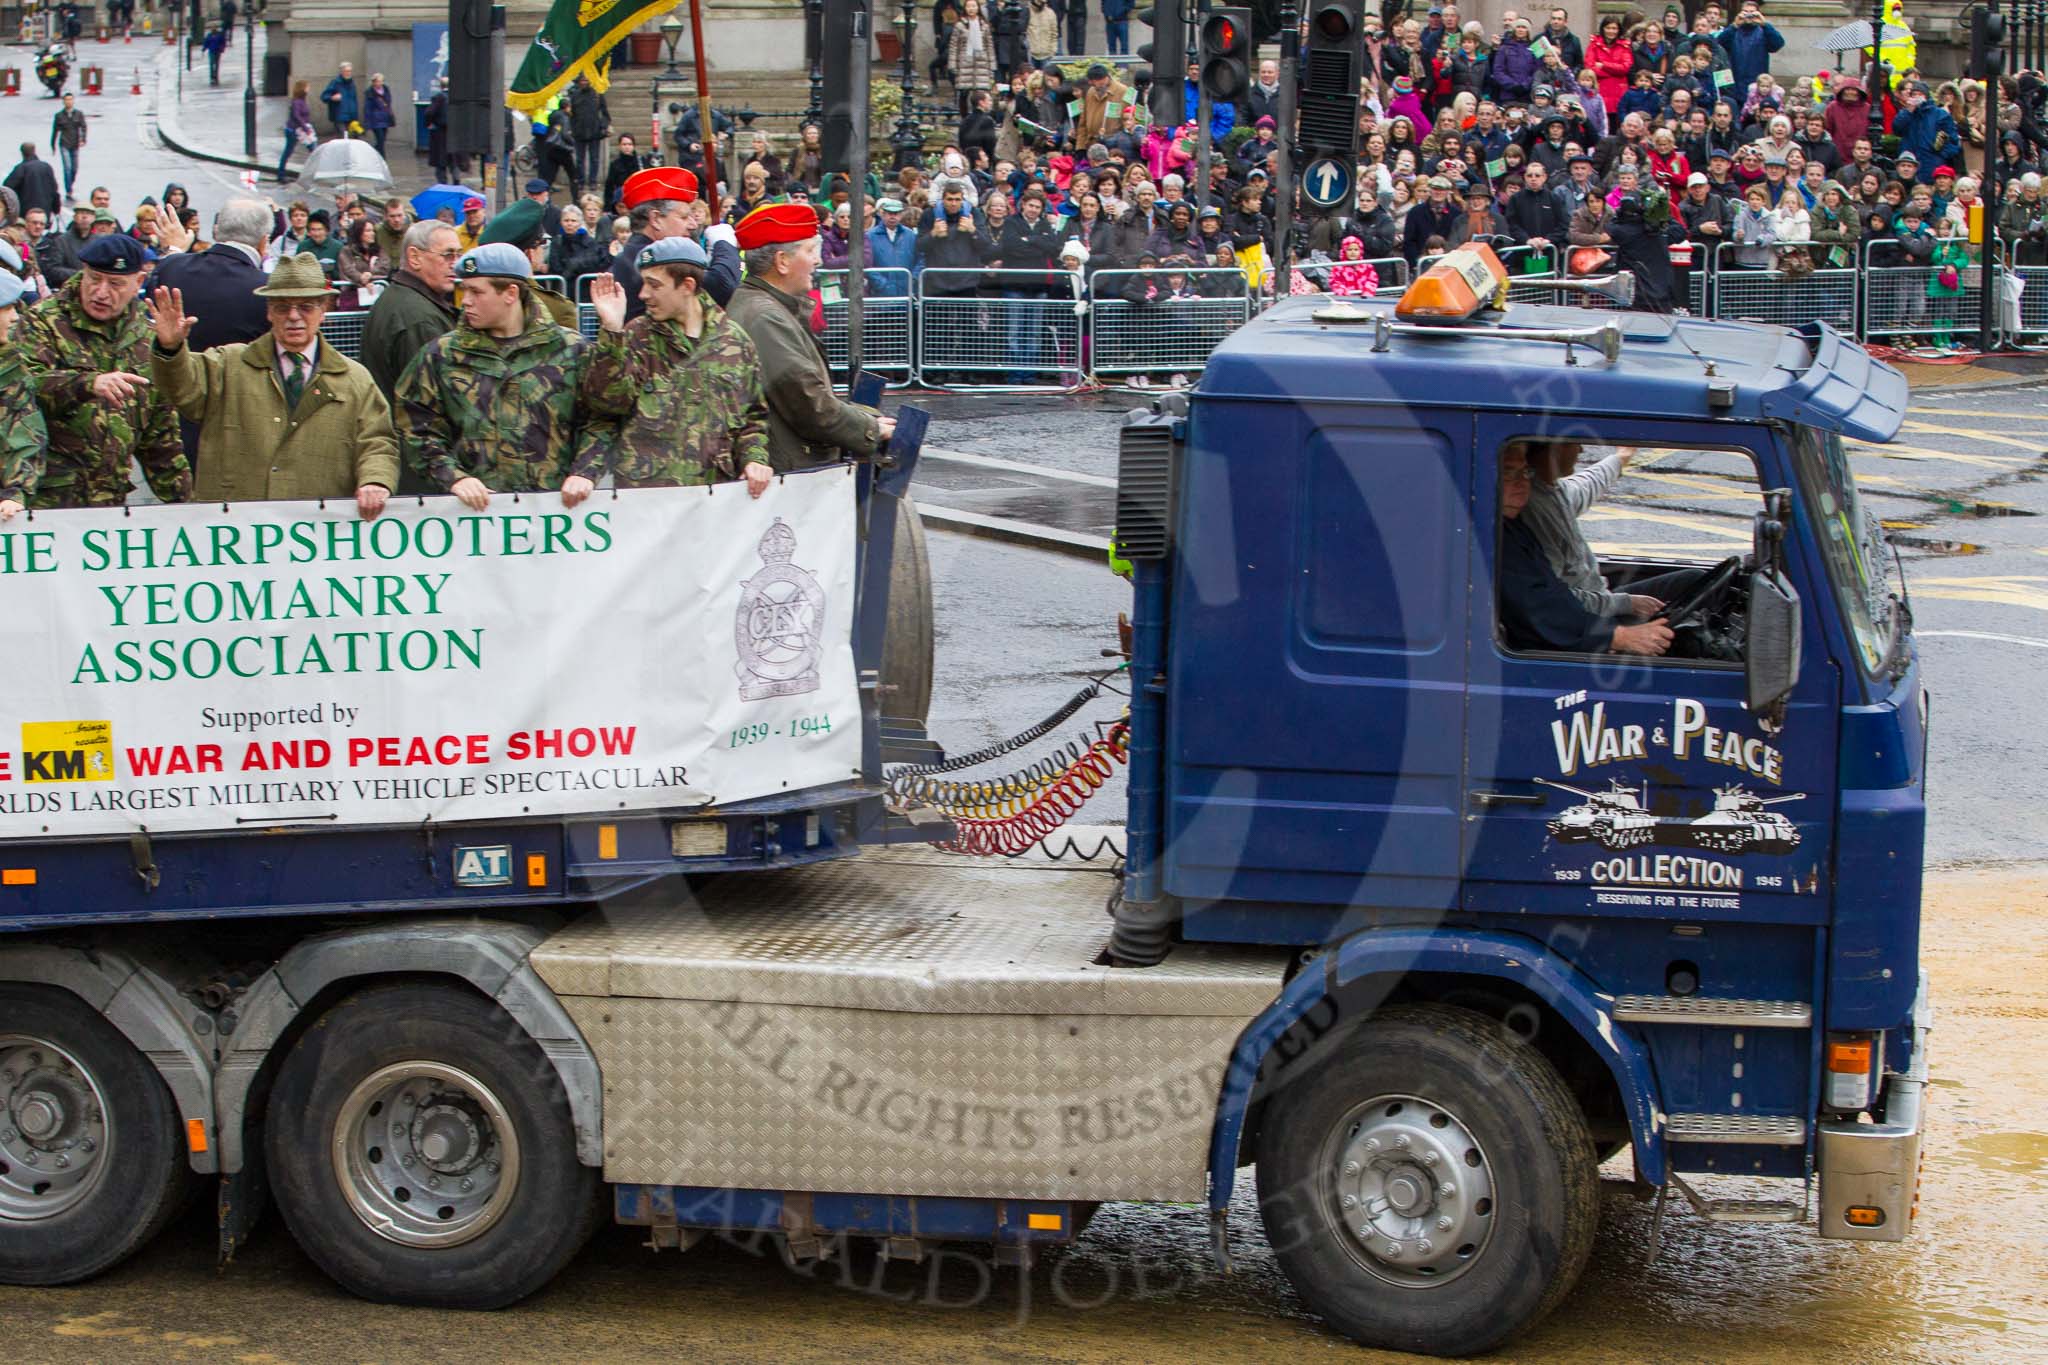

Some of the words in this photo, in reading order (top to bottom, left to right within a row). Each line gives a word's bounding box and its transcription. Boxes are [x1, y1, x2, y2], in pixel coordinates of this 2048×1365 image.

[81, 511, 613, 572] SHARPSHOOTERS
[99, 573, 453, 627] YEOMANRY
[71, 628, 486, 685] ASSOCIATION
[1554, 689, 1588, 710] THE
[202, 705, 324, 733] Supported
[332, 703, 360, 728] by
[729, 722, 769, 748] 1939
[790, 713, 833, 738] 1944
[126, 744, 224, 777] WAR
[241, 739, 332, 772] AND
[348, 734, 490, 768] PEACE
[506, 726, 637, 761] SHOW
[1551, 701, 1648, 777] WAR
[1672, 698, 1784, 785] PEACE
[24, 750, 86, 780] KM
[70, 786, 200, 812] LARGEST
[209, 780, 344, 806] MILITARY
[352, 774, 476, 800] VEHICLE
[484, 766, 690, 796] SPECTACULAR
[458, 850, 507, 877] AT
[1553, 870, 1582, 881] 1939
[1590, 854, 1743, 888] COLLECTION
[1754, 875, 1783, 887] 1945
[1654, 895, 1676, 907] FOR
[1679, 896, 1700, 908] THE
[1701, 898, 1741, 910] FUTURE
